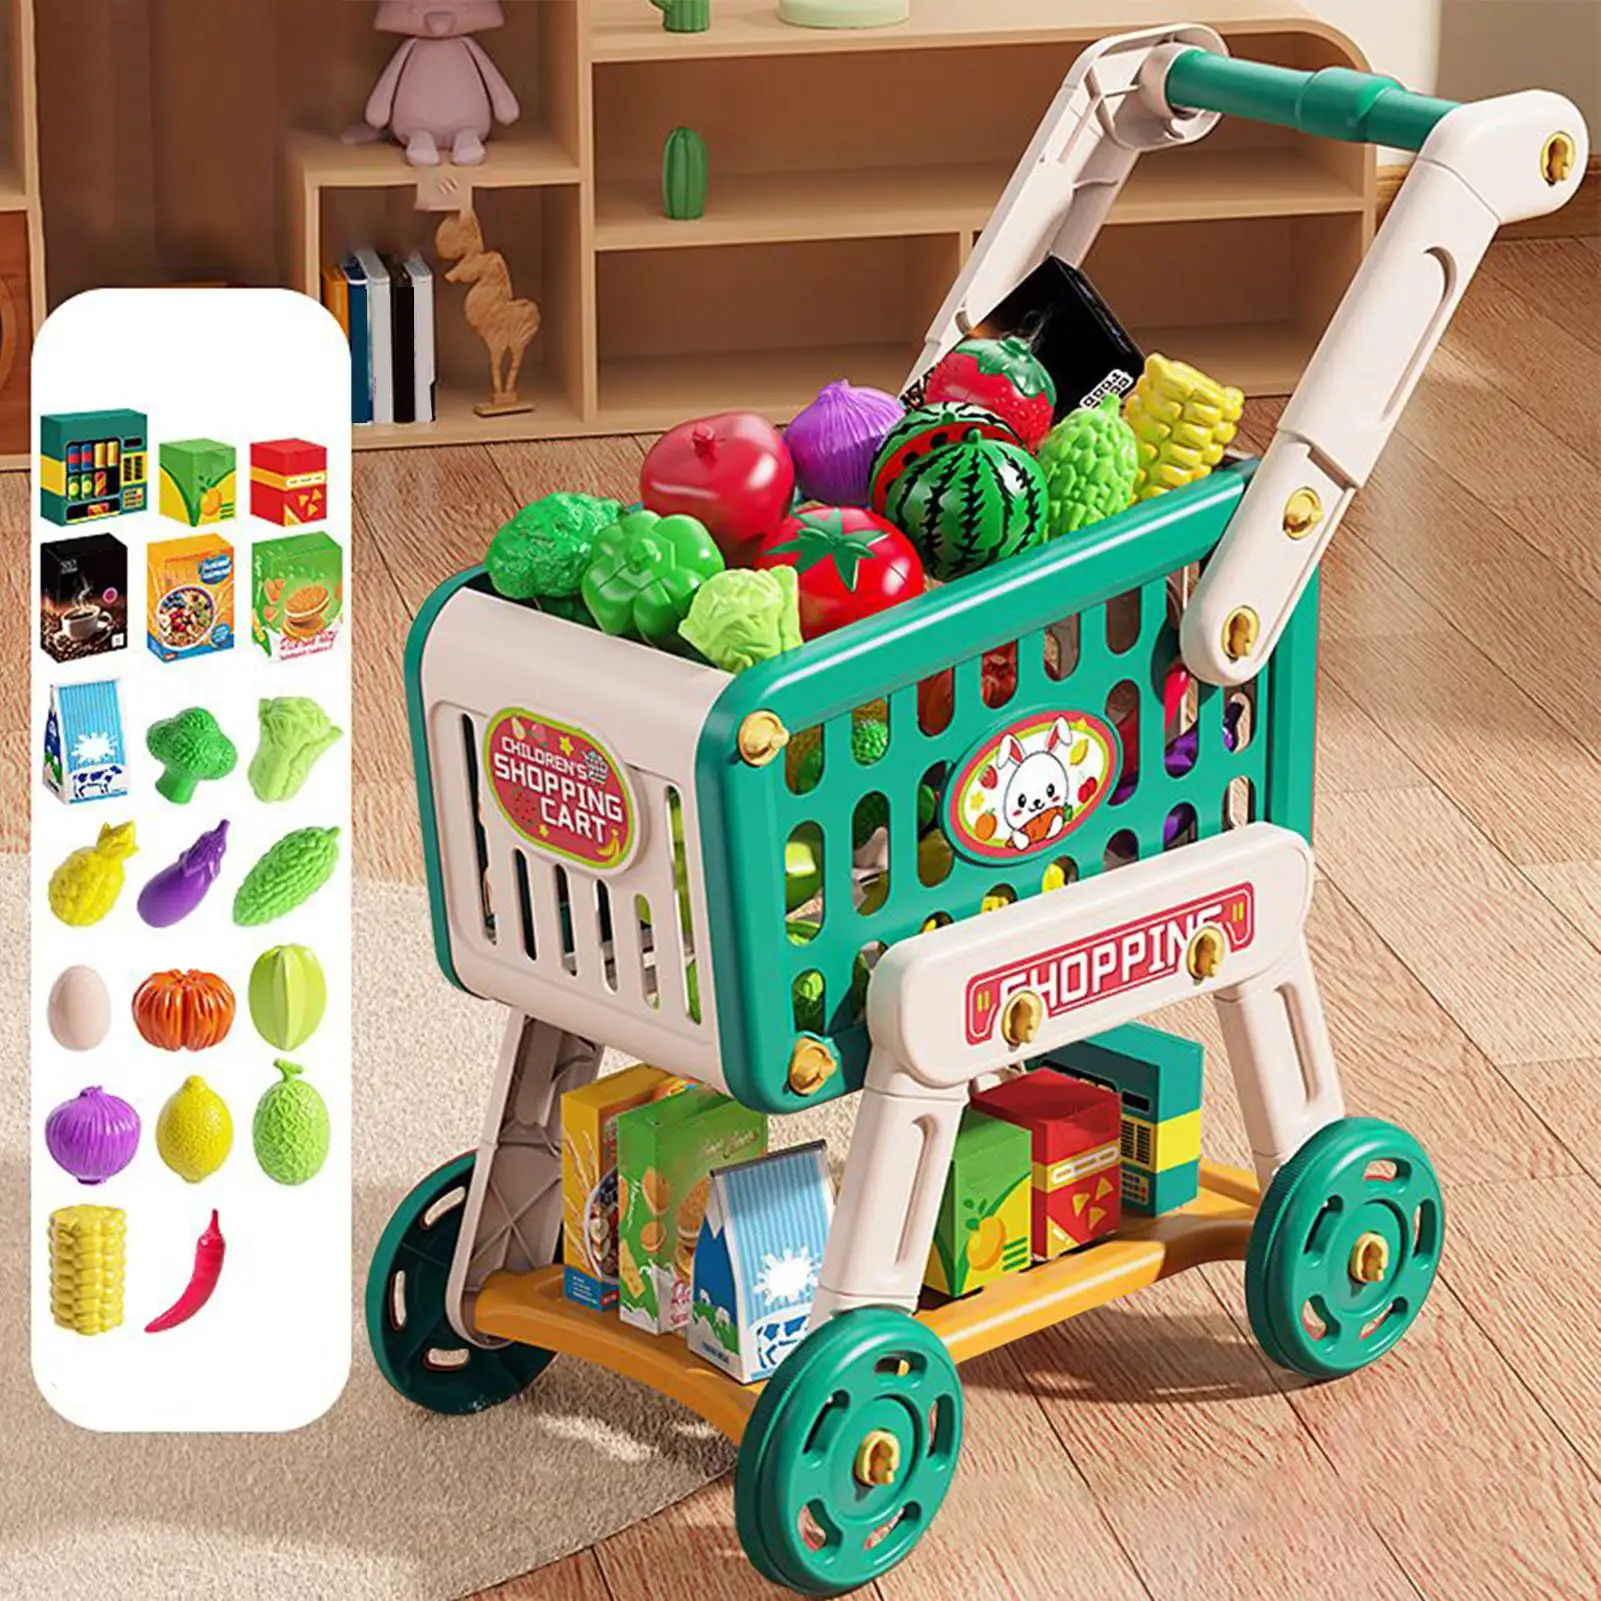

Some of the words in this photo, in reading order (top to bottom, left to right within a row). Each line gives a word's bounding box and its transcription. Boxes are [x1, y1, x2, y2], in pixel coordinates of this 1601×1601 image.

[501, 735, 588, 780] CHILDREN'S
[493, 752, 623, 822] SHOPPING
[540, 796, 607, 843] CART
